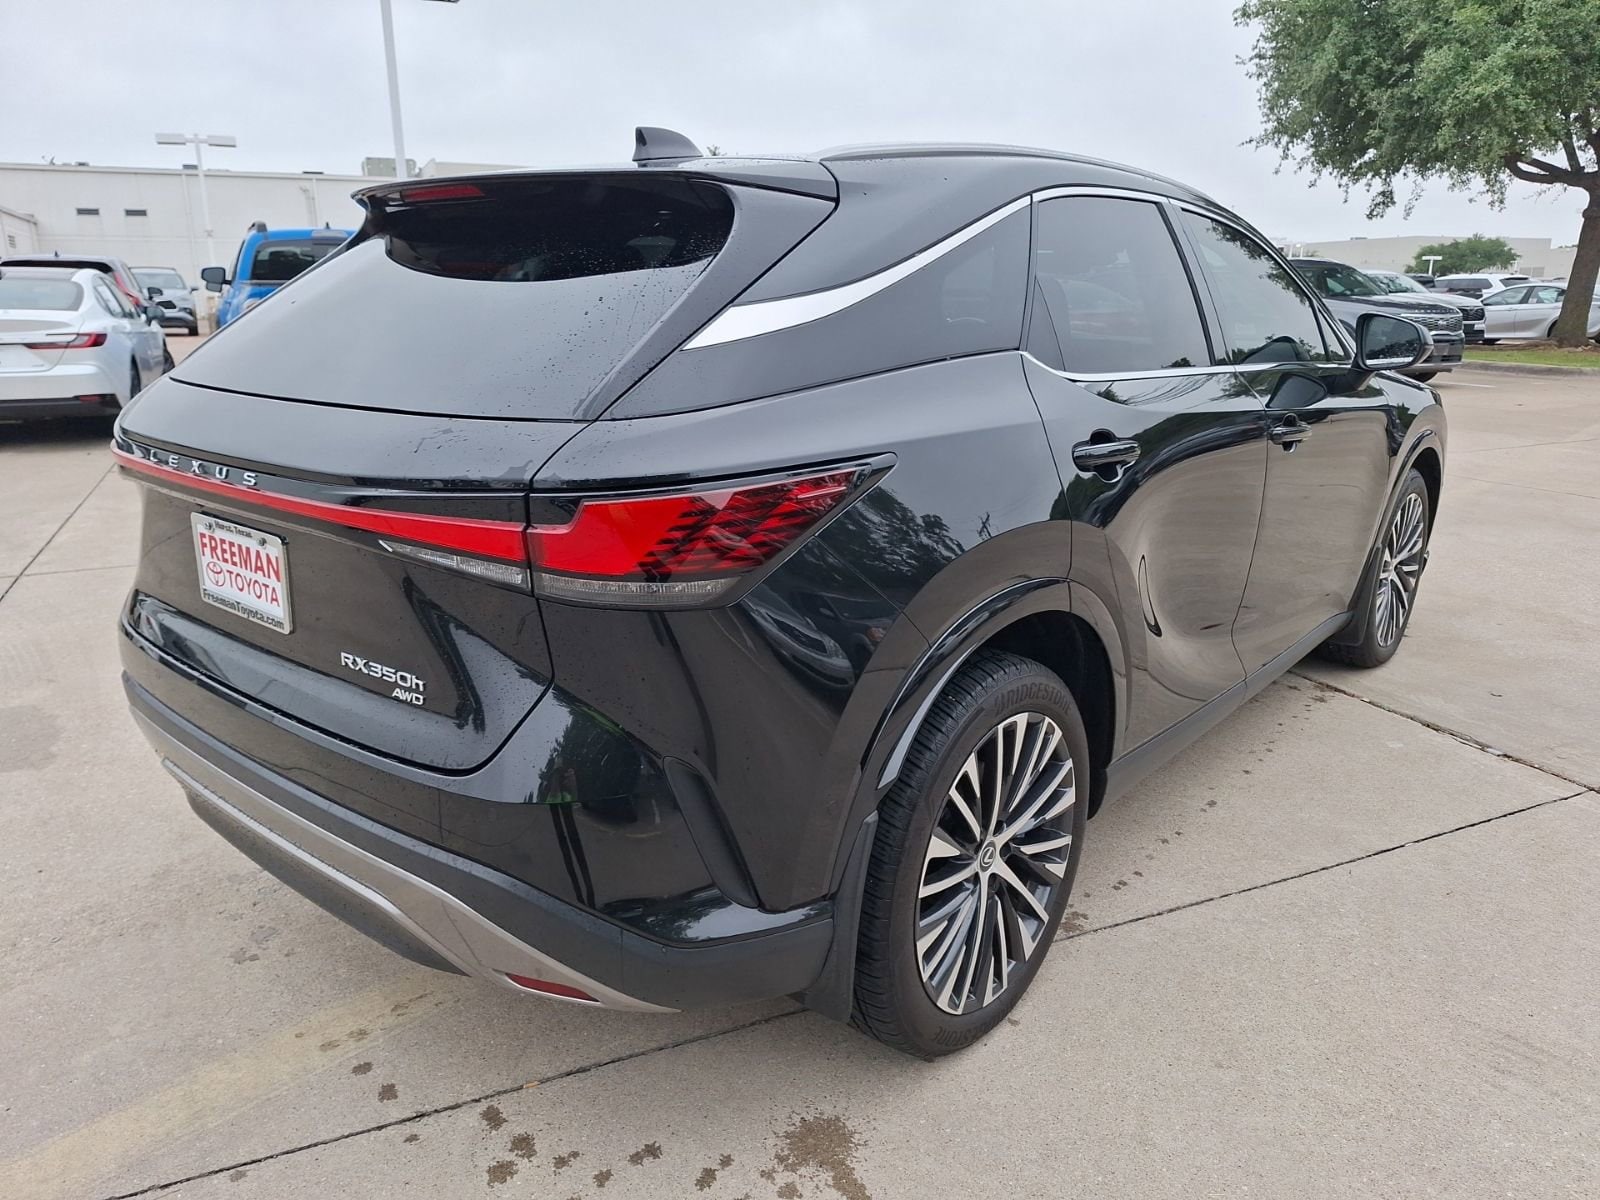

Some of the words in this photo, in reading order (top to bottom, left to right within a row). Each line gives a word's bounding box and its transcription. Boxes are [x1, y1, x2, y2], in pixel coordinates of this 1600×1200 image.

[150, 449, 257, 486] LEXUS
[199, 532, 282, 583] FREEMAN
[226, 569, 281, 608] TOYOTA
[202, 587, 286, 631] FreemanToyota.com
[340, 651, 425, 692] RX350h
[391, 687, 424, 706] AWD
